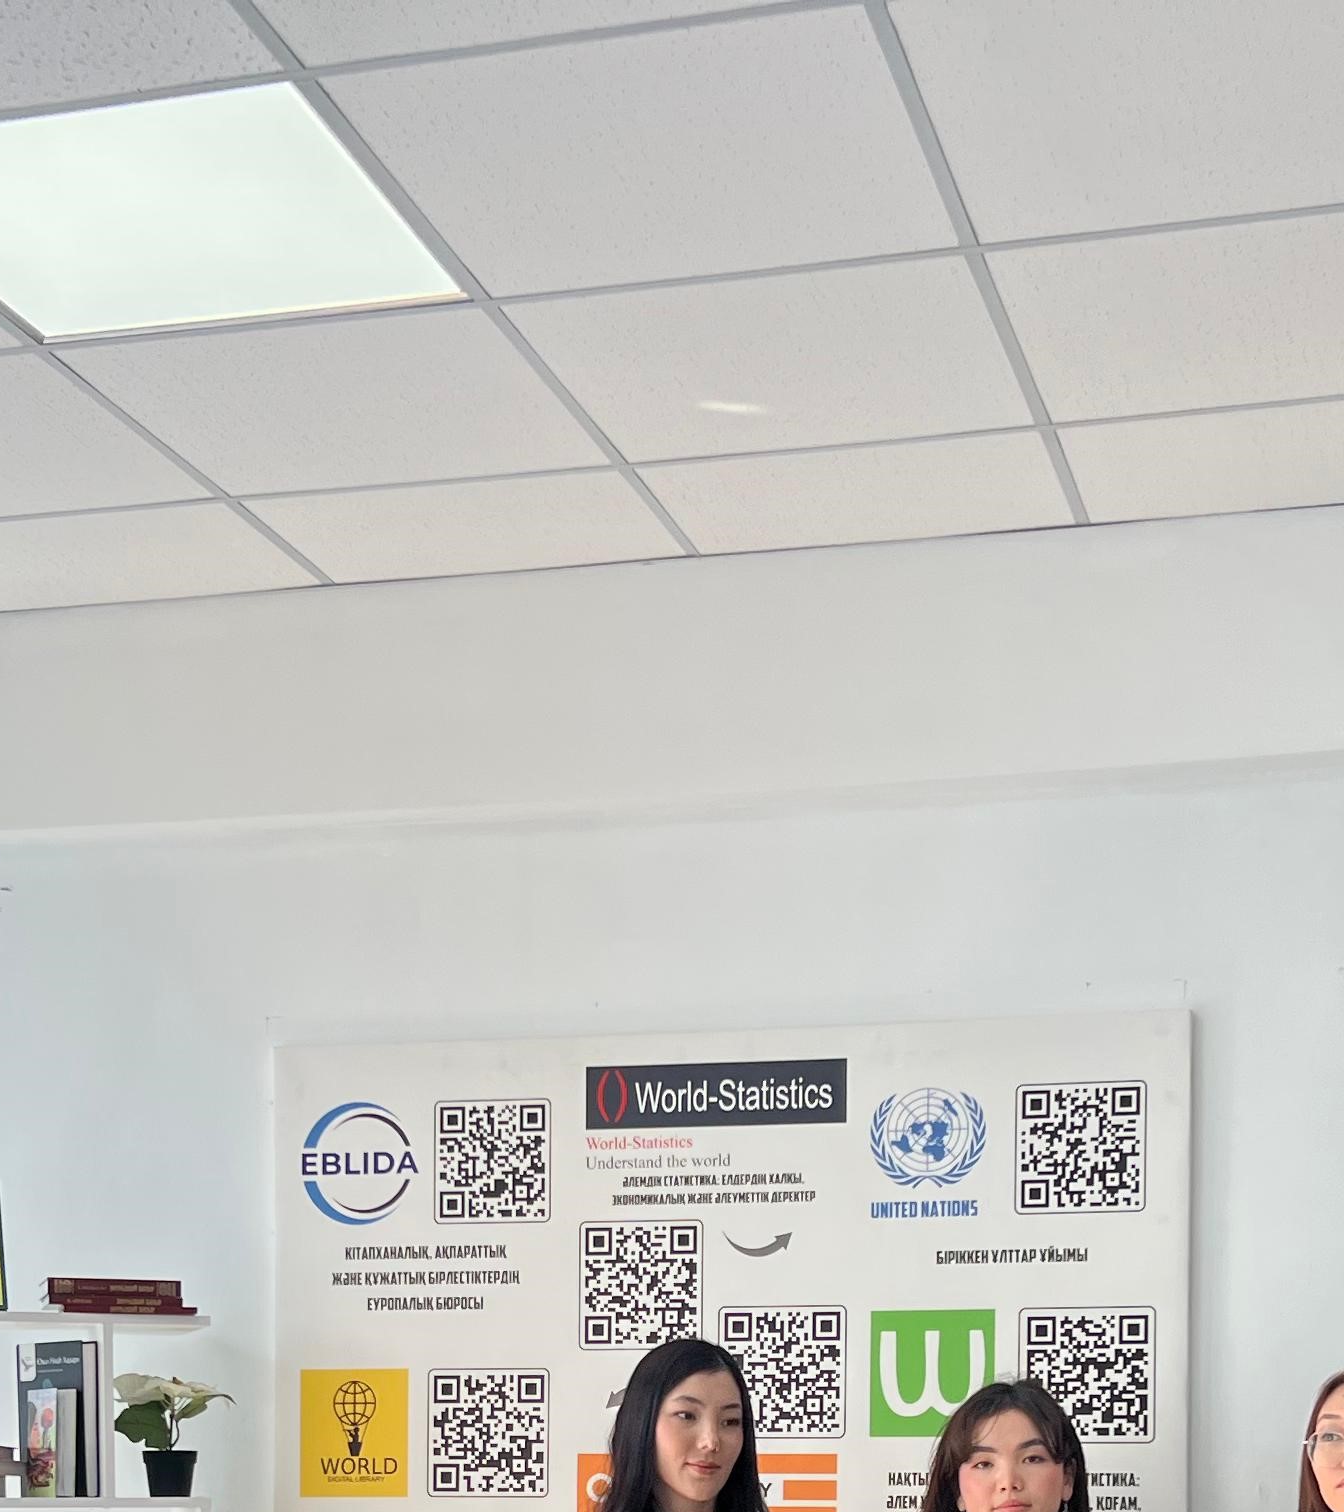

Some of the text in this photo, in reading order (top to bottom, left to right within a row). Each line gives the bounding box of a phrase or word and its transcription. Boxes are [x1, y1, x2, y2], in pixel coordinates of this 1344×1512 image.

[635, 1076, 833, 1114] World-Statistics
[586, 1136, 693, 1151] World-Statistics
[301, 1151, 419, 1176] EBLIDA
[586, 1153, 731, 1170] Understand the world
[870, 1200, 978, 1219] UNITED NATIONS
[434, 1244, 507, 1260] АҚПАРАТТЫҚ
[936, 1245, 1089, 1265] БІРІККЕН ҰЛТТАР ҰЙЫМЫ
[331, 1271, 363, 1286] ЖӘНЕ
[364, 1271, 426, 1286] ҚҰЖАТТЫҚ
[367, 1296, 484, 1312] ЕУРОПАЛЫҚ БЮРОСЫ
[321, 1457, 398, 1475] WORLD
[1085, 1472, 1141, 1487] ТИСТИКА:
